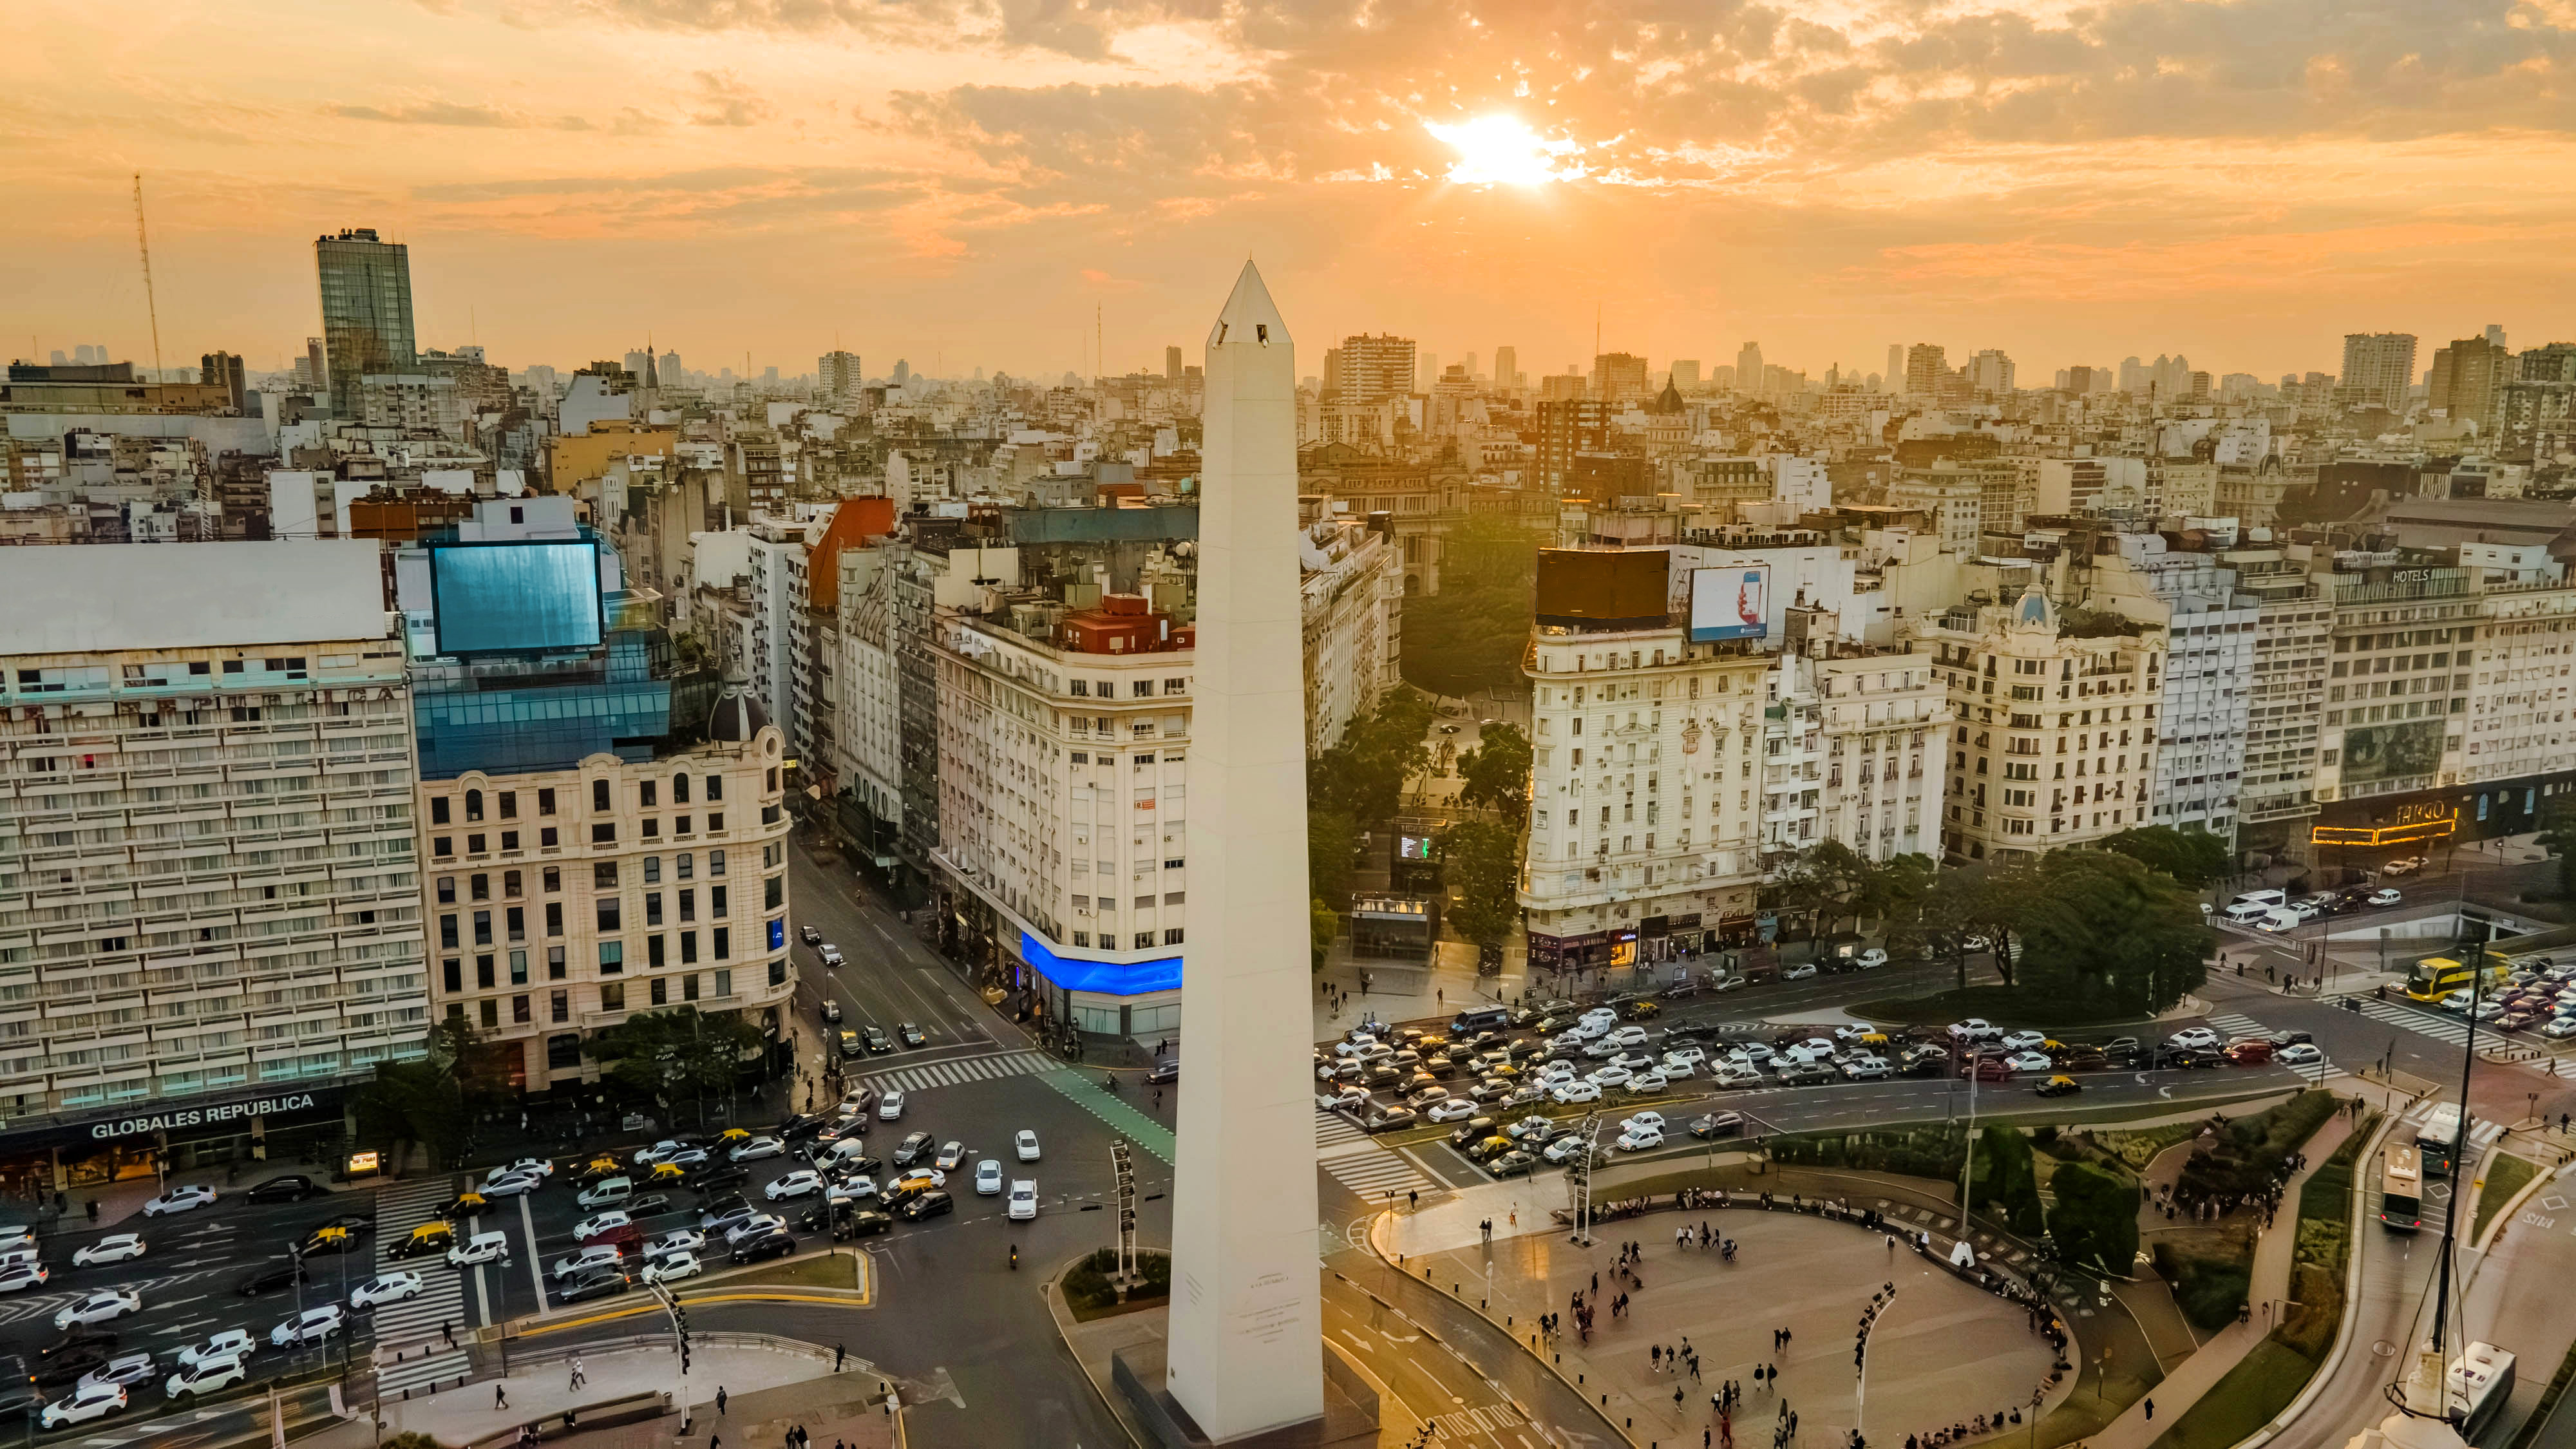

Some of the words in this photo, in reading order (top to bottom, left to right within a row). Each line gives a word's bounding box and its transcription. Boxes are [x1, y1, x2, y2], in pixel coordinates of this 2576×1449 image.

[2393, 569, 2429, 583] HOTELS
[91, 1110, 201, 1139] GLOBALES
[206, 1094, 314, 1122] REPÚBLICA
